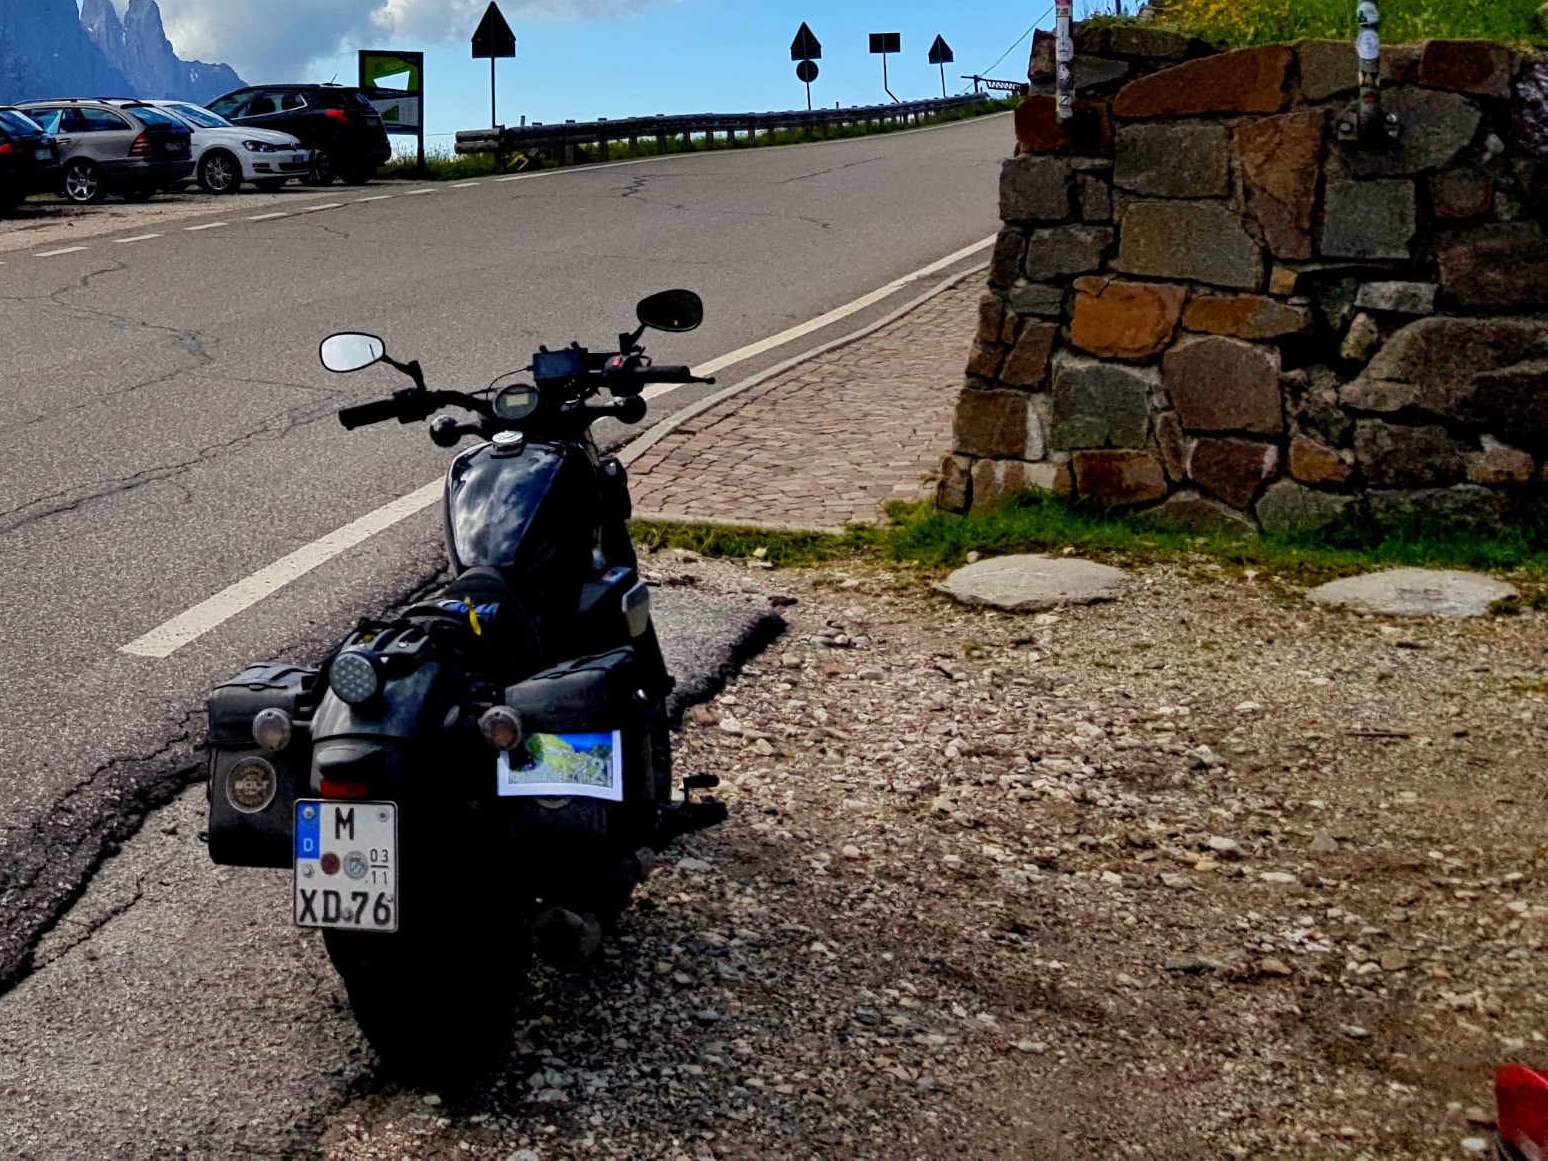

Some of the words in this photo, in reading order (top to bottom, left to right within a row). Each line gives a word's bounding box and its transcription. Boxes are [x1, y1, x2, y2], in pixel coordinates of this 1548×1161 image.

[334, 806, 355, 840] M
[303, 837, 313, 852] D
[370, 848, 389, 862] 03
[371, 870, 388, 885] 11
[298, 888, 341, 923] XD
[350, 890, 392, 926] 76
